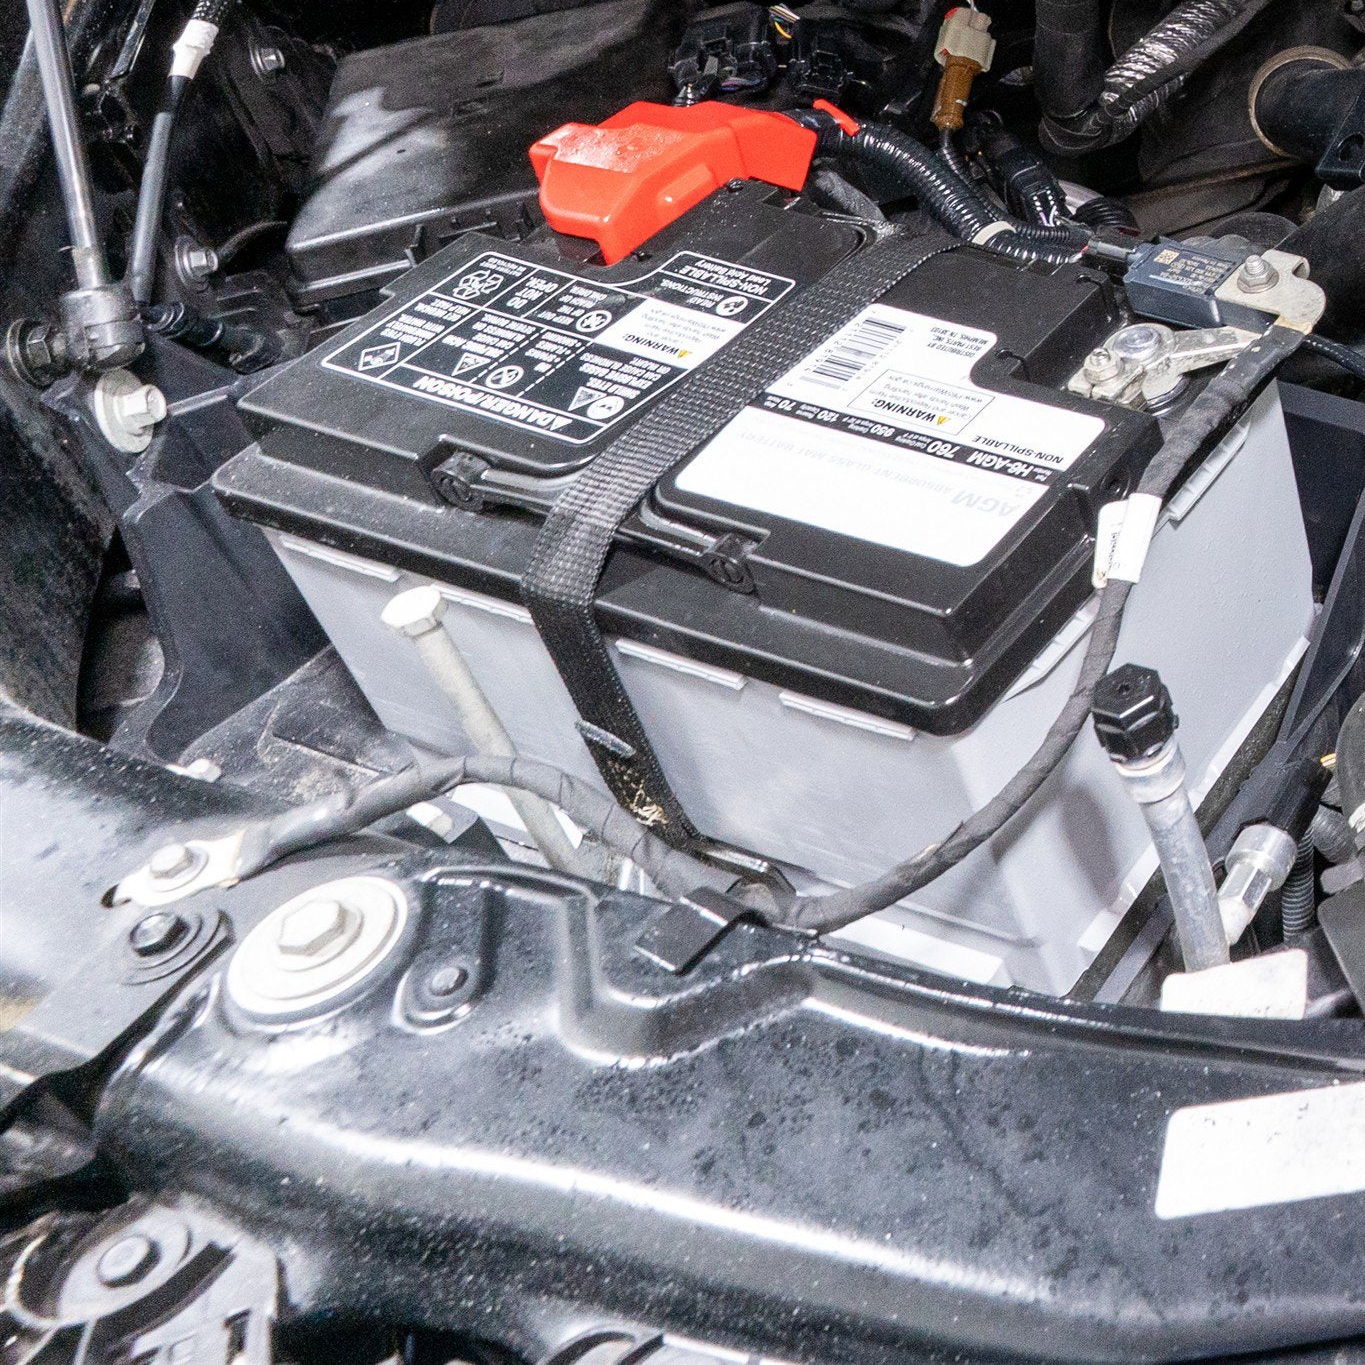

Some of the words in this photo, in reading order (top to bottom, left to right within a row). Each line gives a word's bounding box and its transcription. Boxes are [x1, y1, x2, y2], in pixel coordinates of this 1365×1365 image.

[692, 259, 730, 274] Battery
[725, 268, 749, 279] Acid
[521, 277, 560, 292] OPEN.
[678, 265, 768, 295] NON-SPILLABLE
[744, 274, 772, 285] Lead
[513, 287, 544, 300] NOT
[657, 279, 724, 301] INSTRUCTIONS.
[504, 297, 529, 308] DO
[687, 296, 715, 307] READ
[619, 333, 680, 354] WARNING:
[411, 376, 557, 426] DANGER/POISON
[774, 399, 799, 410] 70
[814, 410, 842, 422] 120
[866, 398, 939, 421] WARNING:
[867, 424, 897, 436] 950
[923, 440, 962, 457] 760
[970, 434, 1064, 464] NON-SPILLABLE
[965, 451, 1034, 476] H6-AGM
